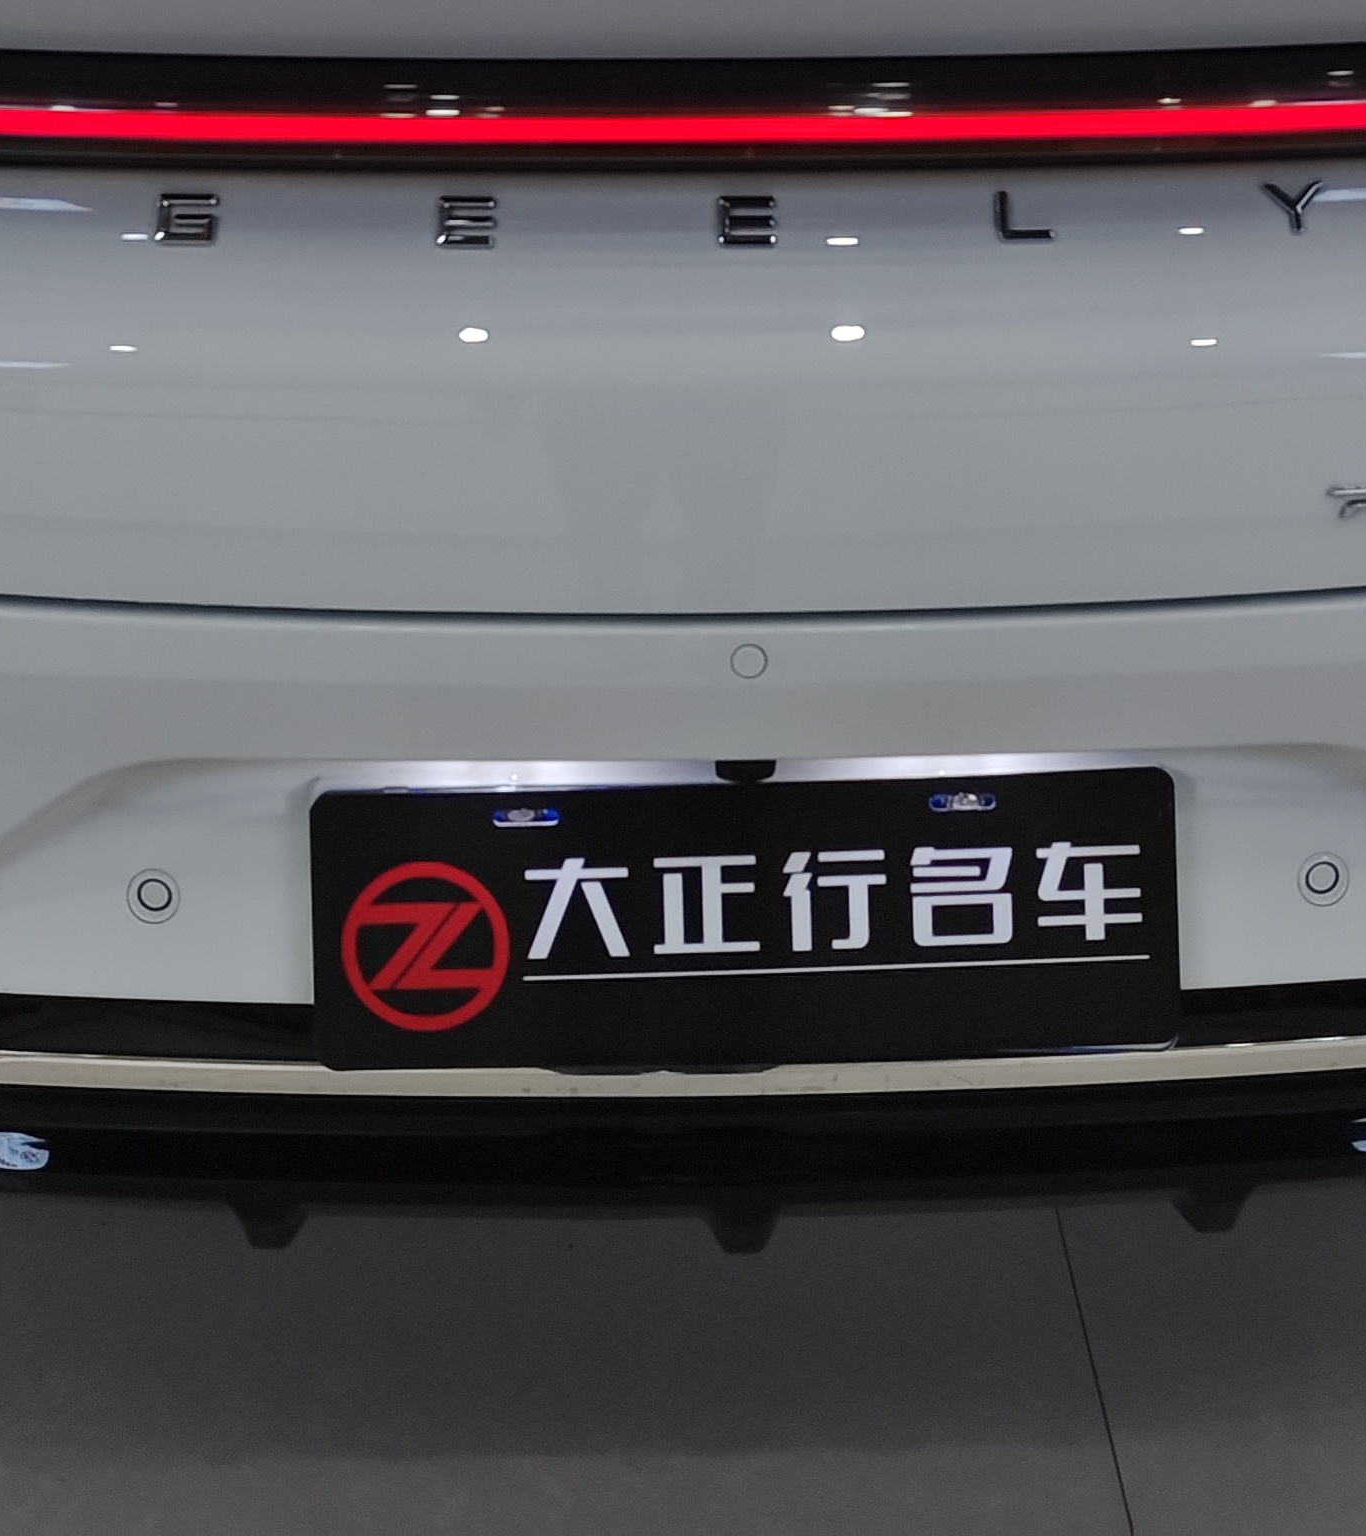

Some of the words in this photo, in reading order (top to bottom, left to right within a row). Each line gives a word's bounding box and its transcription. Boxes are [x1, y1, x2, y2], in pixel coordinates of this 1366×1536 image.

[154, 180, 1323, 248] GEELY
[523, 841, 1145, 961] 大正行名车
